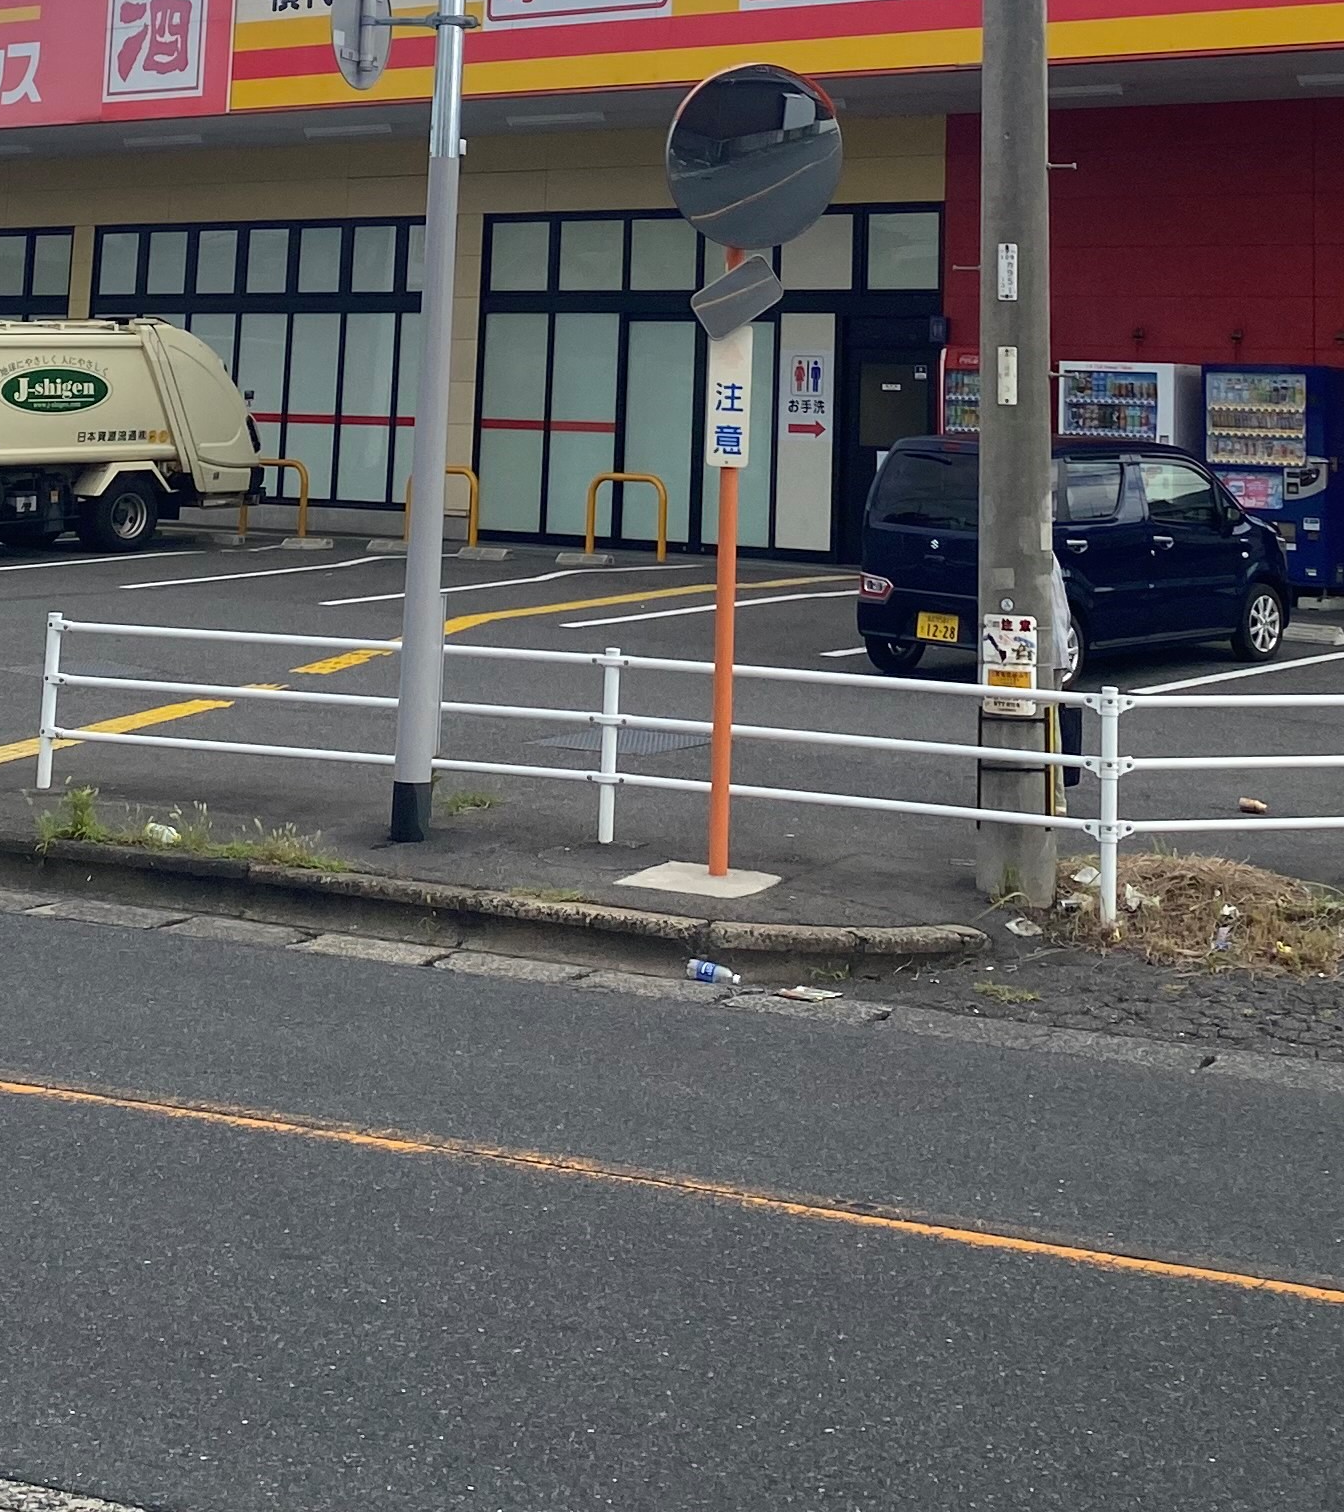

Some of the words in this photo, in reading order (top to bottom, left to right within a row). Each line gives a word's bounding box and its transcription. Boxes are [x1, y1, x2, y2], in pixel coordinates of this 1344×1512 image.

[13, 377, 95, 402] J-shigen
[714, 383, 744, 455] 注意
[787, 399, 826, 414] お手洗
